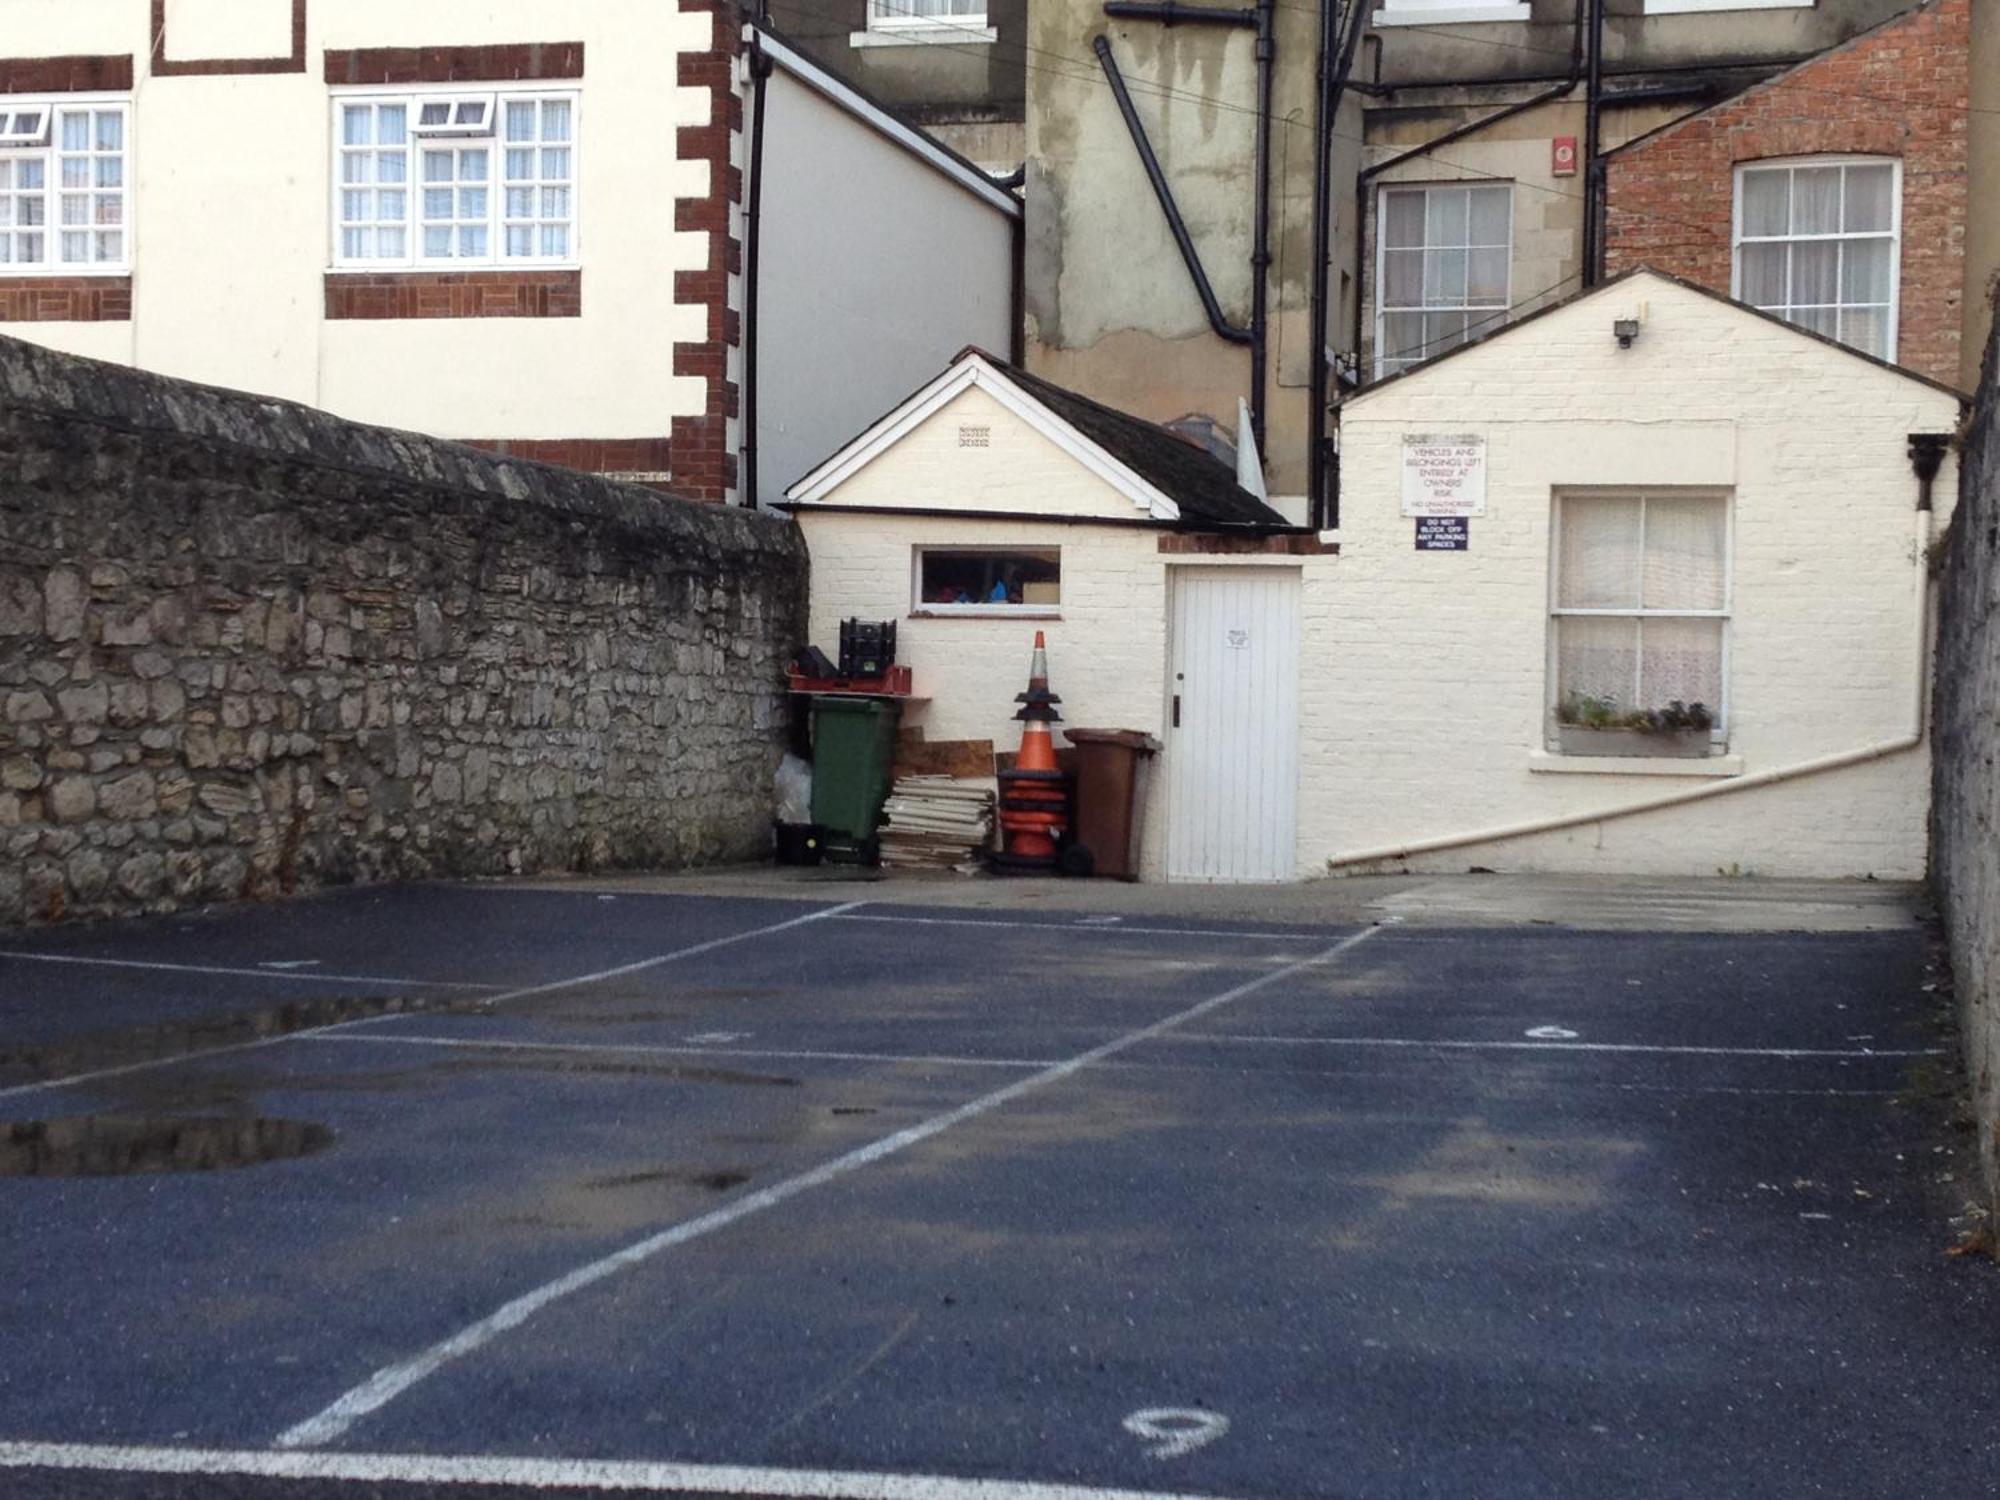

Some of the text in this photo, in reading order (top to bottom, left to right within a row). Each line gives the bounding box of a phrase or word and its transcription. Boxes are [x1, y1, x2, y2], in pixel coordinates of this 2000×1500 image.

[1414, 448, 1476, 456] VEHICLES AND
[1465, 458, 1481, 467] LEFT
[1458, 469, 1469, 477] AT
[1433, 489, 1452, 497] RISK
[1420, 526, 1462, 534] BLOCK OFF
[1417, 533, 1467, 542] ANY PARKING
[1427, 541, 1456, 549] SPACES
[1121, 1407, 1231, 1461] 9
